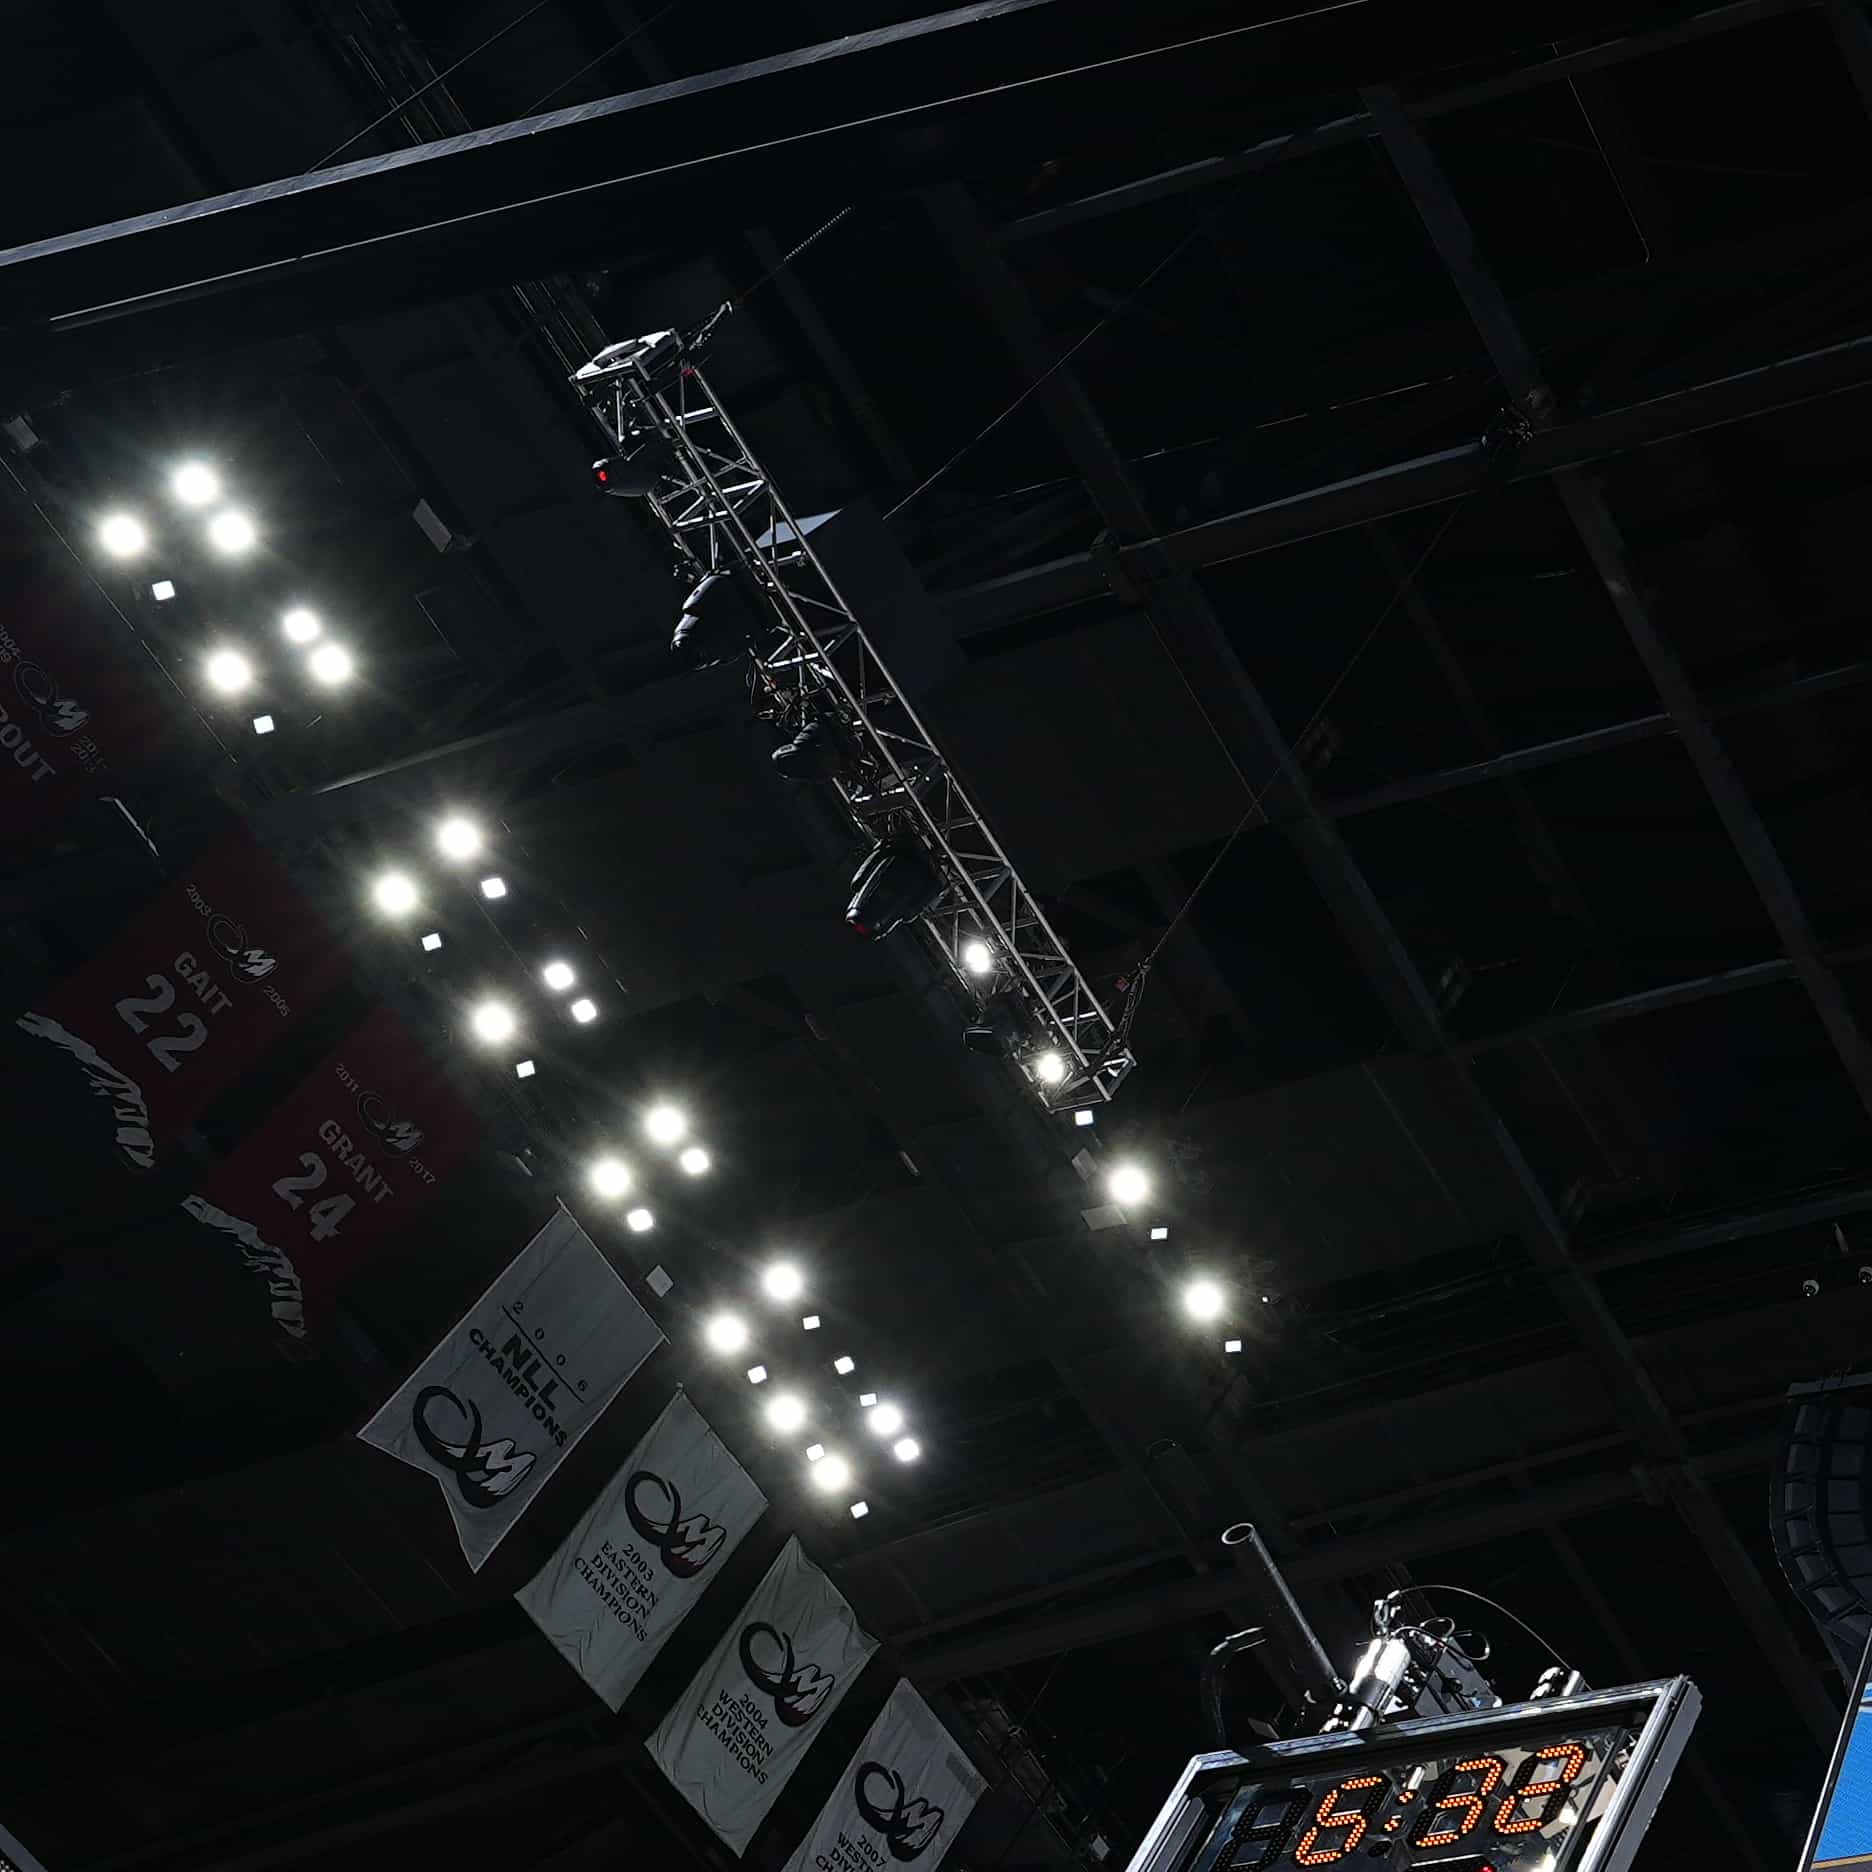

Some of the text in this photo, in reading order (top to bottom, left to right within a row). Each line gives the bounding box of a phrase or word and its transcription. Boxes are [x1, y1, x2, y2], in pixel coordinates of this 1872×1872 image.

[174, 951, 233, 1015] GAIT
[114, 973, 209, 1074] 22
[318, 1119, 395, 1205] GRANT
[271, 1151, 357, 1243] 24
[469, 1328, 568, 1447] CHAMPIONS
[501, 1333, 559, 1412] NLL
[591, 1553, 650, 1619] DIVISION
[600, 1540, 660, 1607] EASTERN
[622, 1543, 655, 1582] 2003
[574, 1557, 649, 1642] CHAMPIONS
[696, 1704, 769, 1785] CHAMPIONS
[710, 1702, 765, 1766] DIVISION
[718, 1689, 774, 1757] WESTERN
[739, 1694, 769, 1730] 2004
[857, 1834, 887, 1868] 2007
